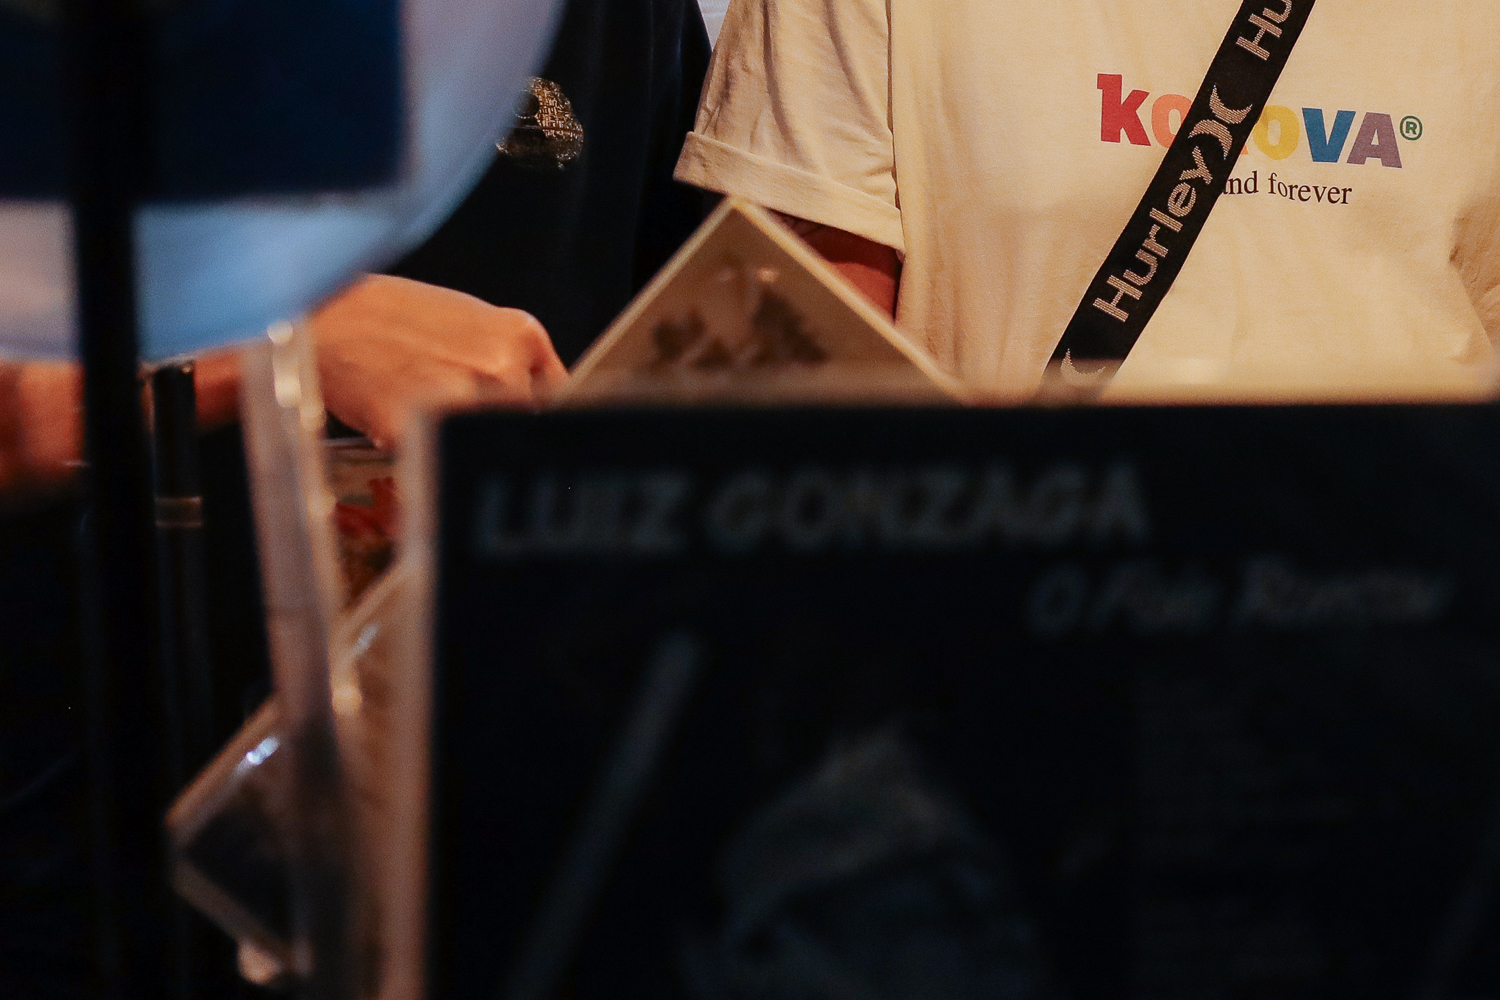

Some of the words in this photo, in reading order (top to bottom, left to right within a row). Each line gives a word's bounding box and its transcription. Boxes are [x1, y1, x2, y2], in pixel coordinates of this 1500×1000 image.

[1092, 146, 1213, 322] Hurley
[1223, 170, 1258, 195] nd
[1267, 172, 1353, 205] forever
[474, 468, 692, 559] LUIZ
[706, 457, 1151, 554] GONZAGA
